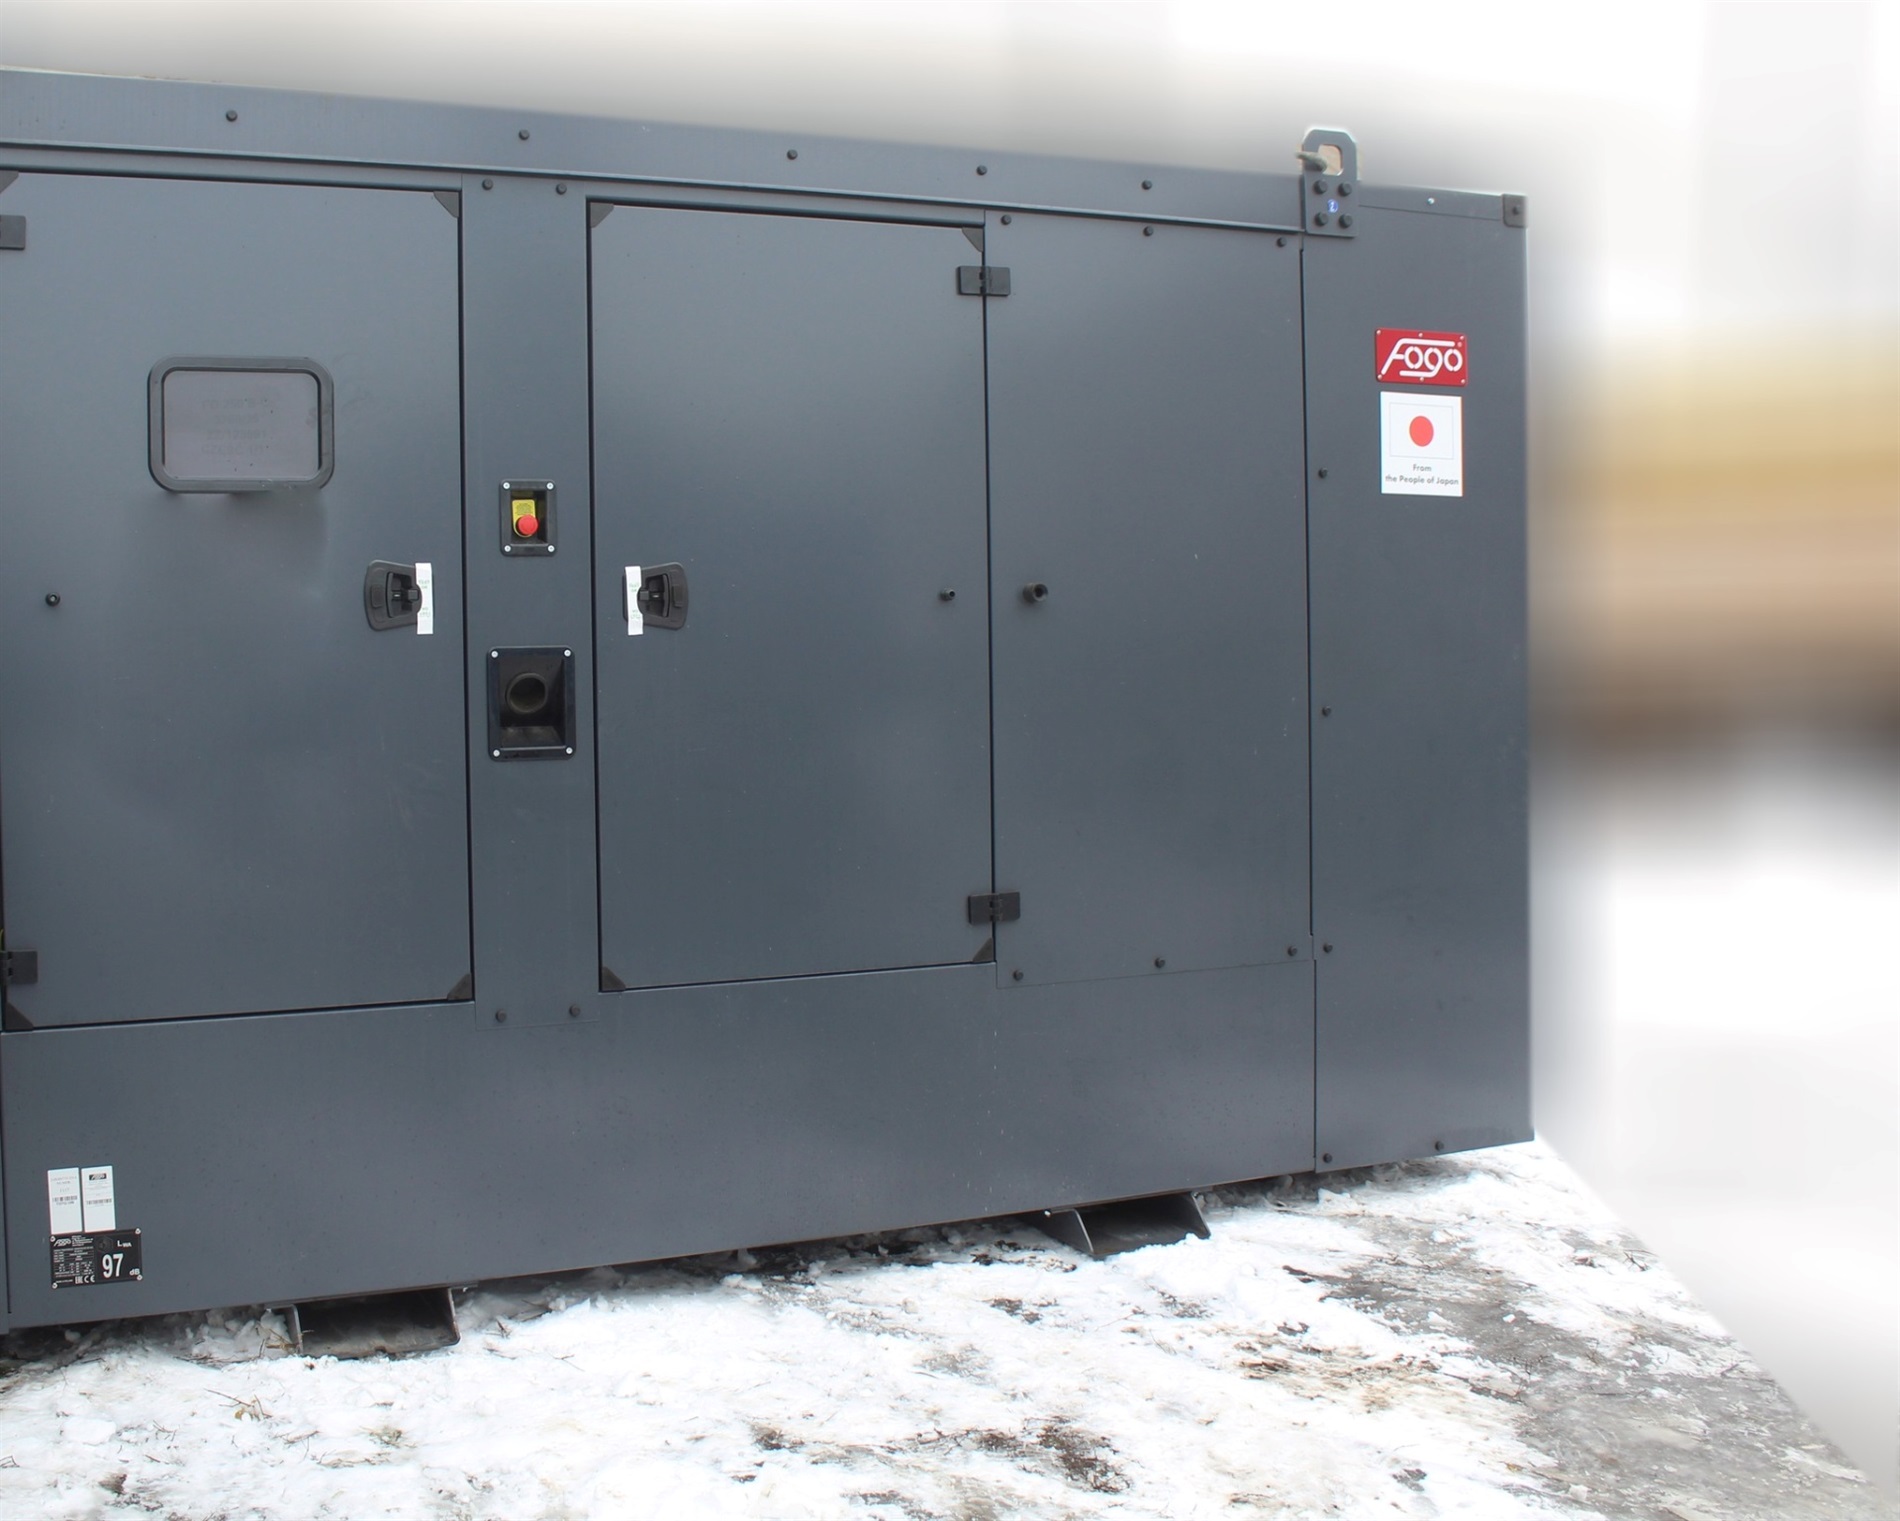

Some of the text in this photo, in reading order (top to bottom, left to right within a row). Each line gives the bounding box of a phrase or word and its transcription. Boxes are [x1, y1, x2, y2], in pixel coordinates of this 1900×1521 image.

[1413, 463, 1432, 472] From
[1385, 474, 1459, 487] the People of Japan
[102, 1253, 123, 1278] 97
